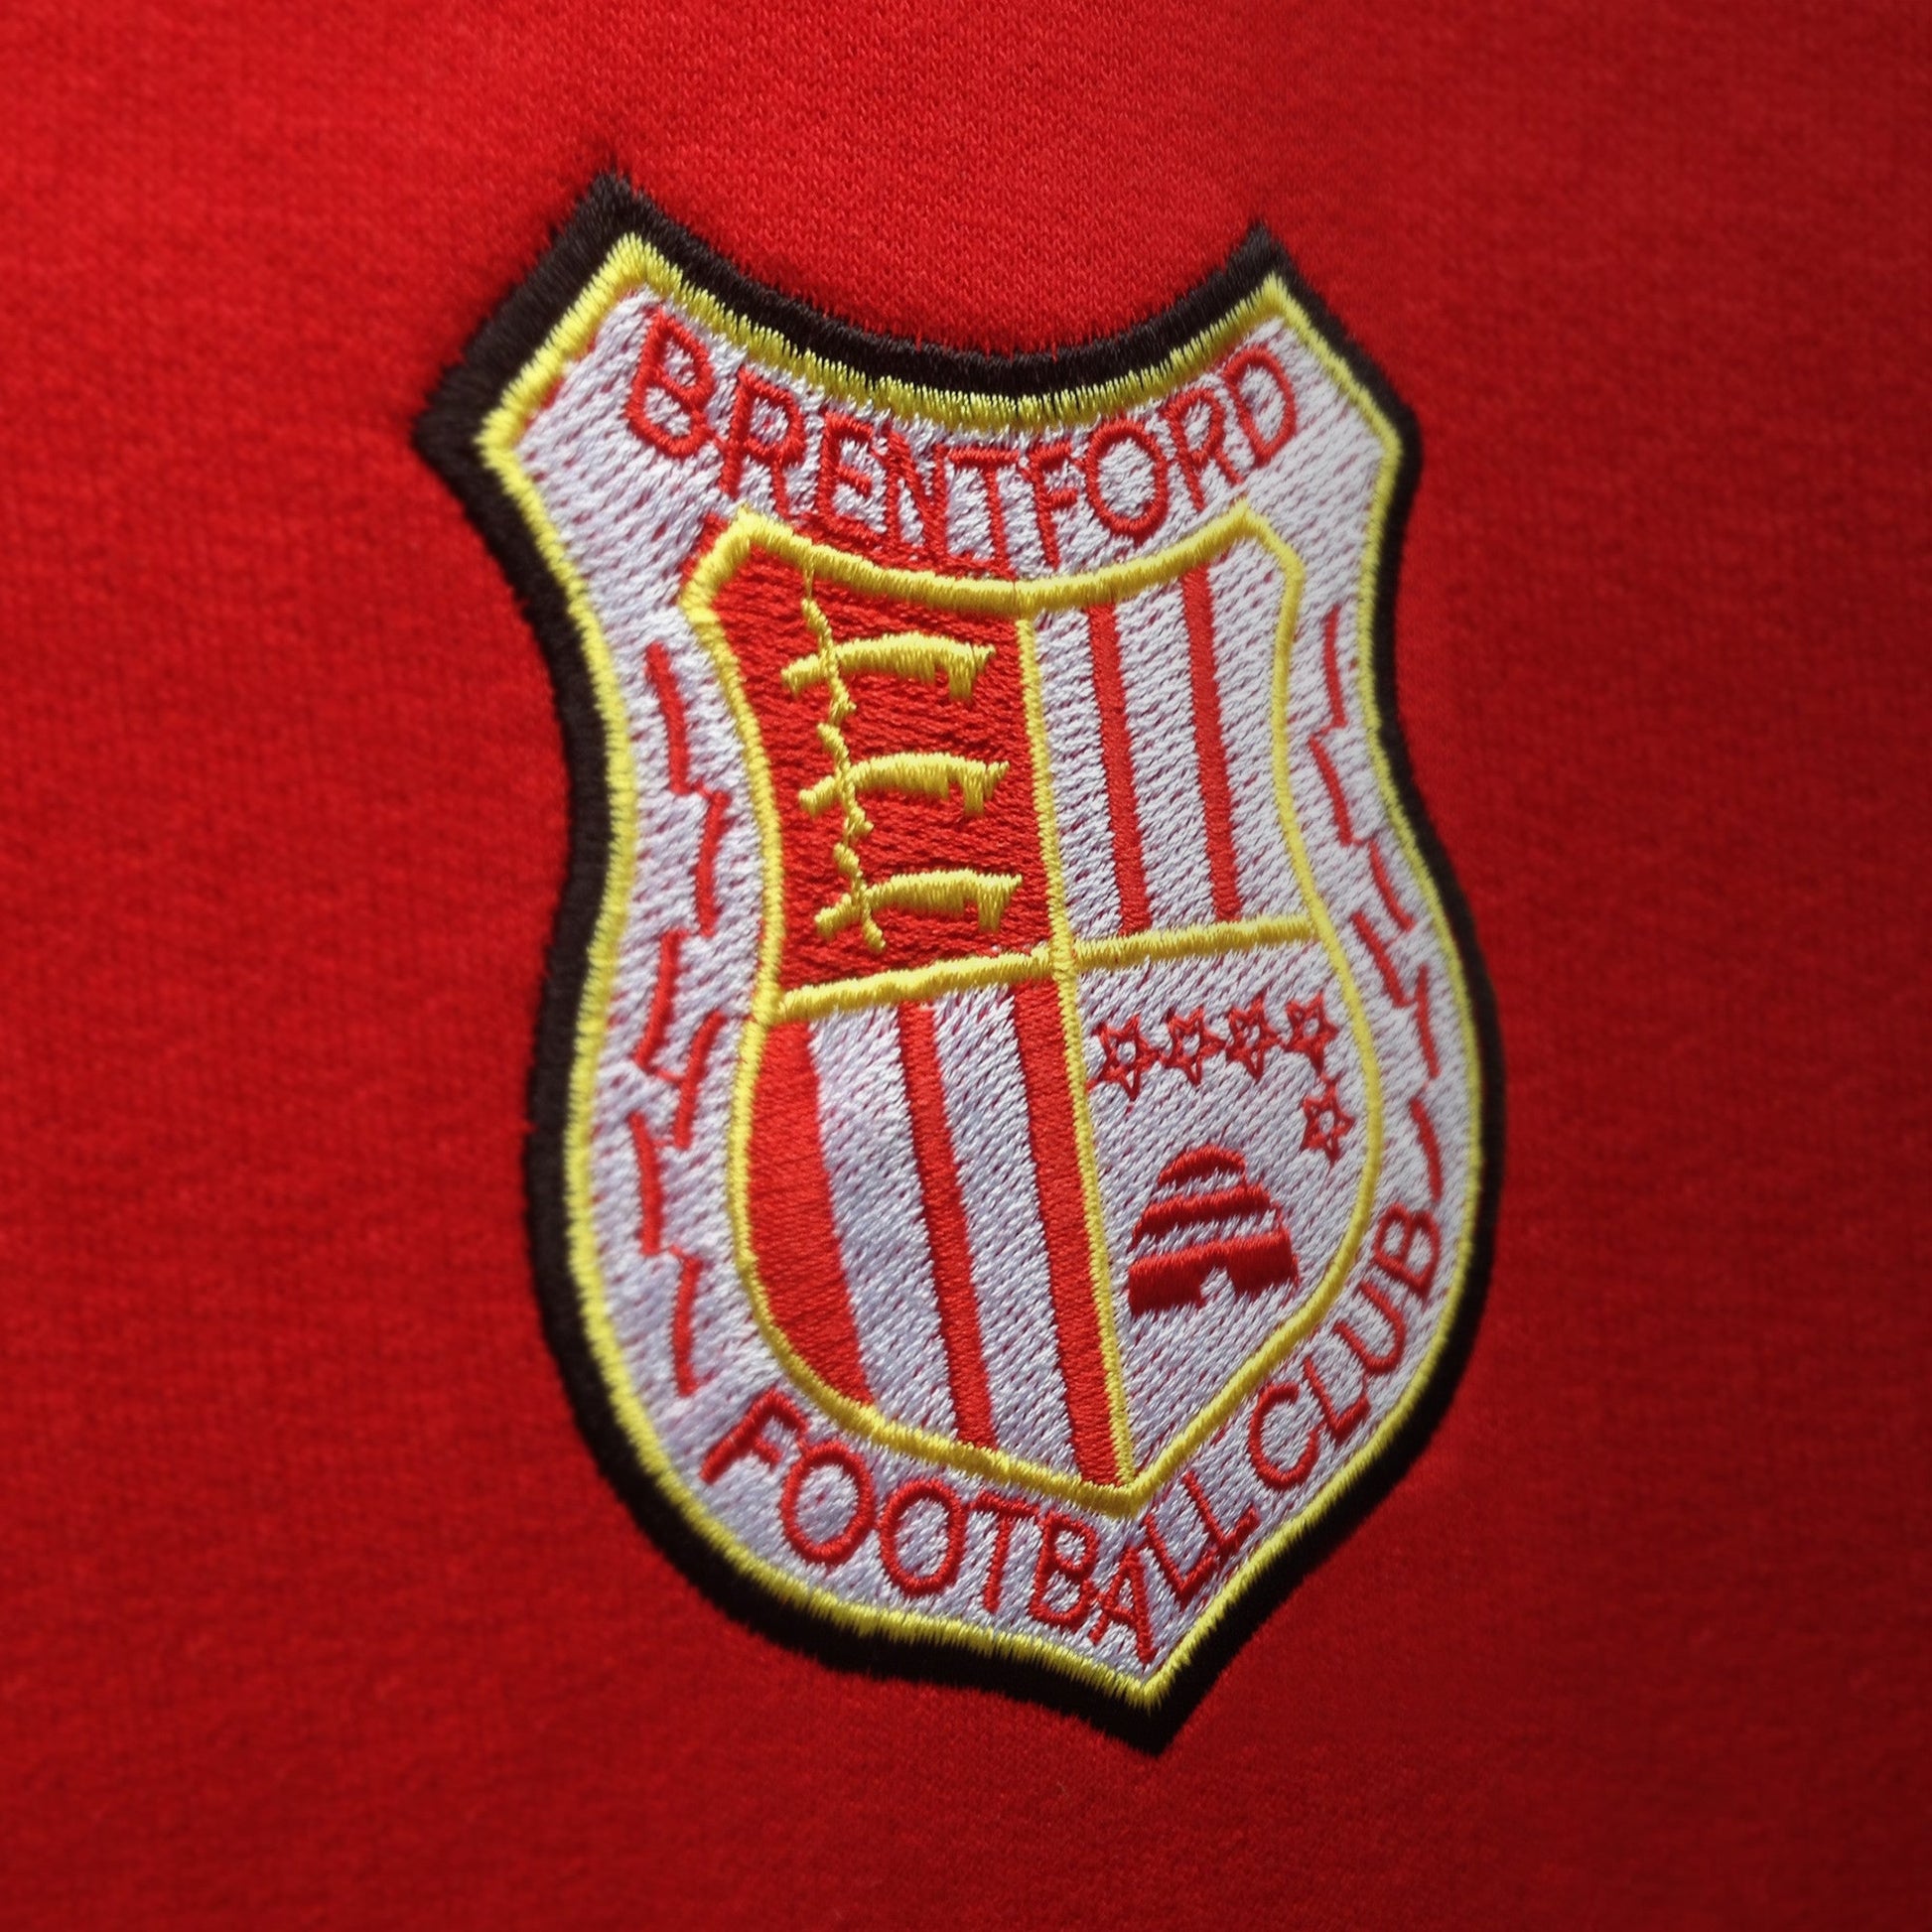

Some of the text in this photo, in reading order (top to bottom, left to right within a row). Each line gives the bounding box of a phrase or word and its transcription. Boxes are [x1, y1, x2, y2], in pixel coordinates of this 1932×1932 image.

[623, 310, 1298, 576] BRENTFORD
[700, 1202, 1441, 1666] FOOTBALL CLUB
